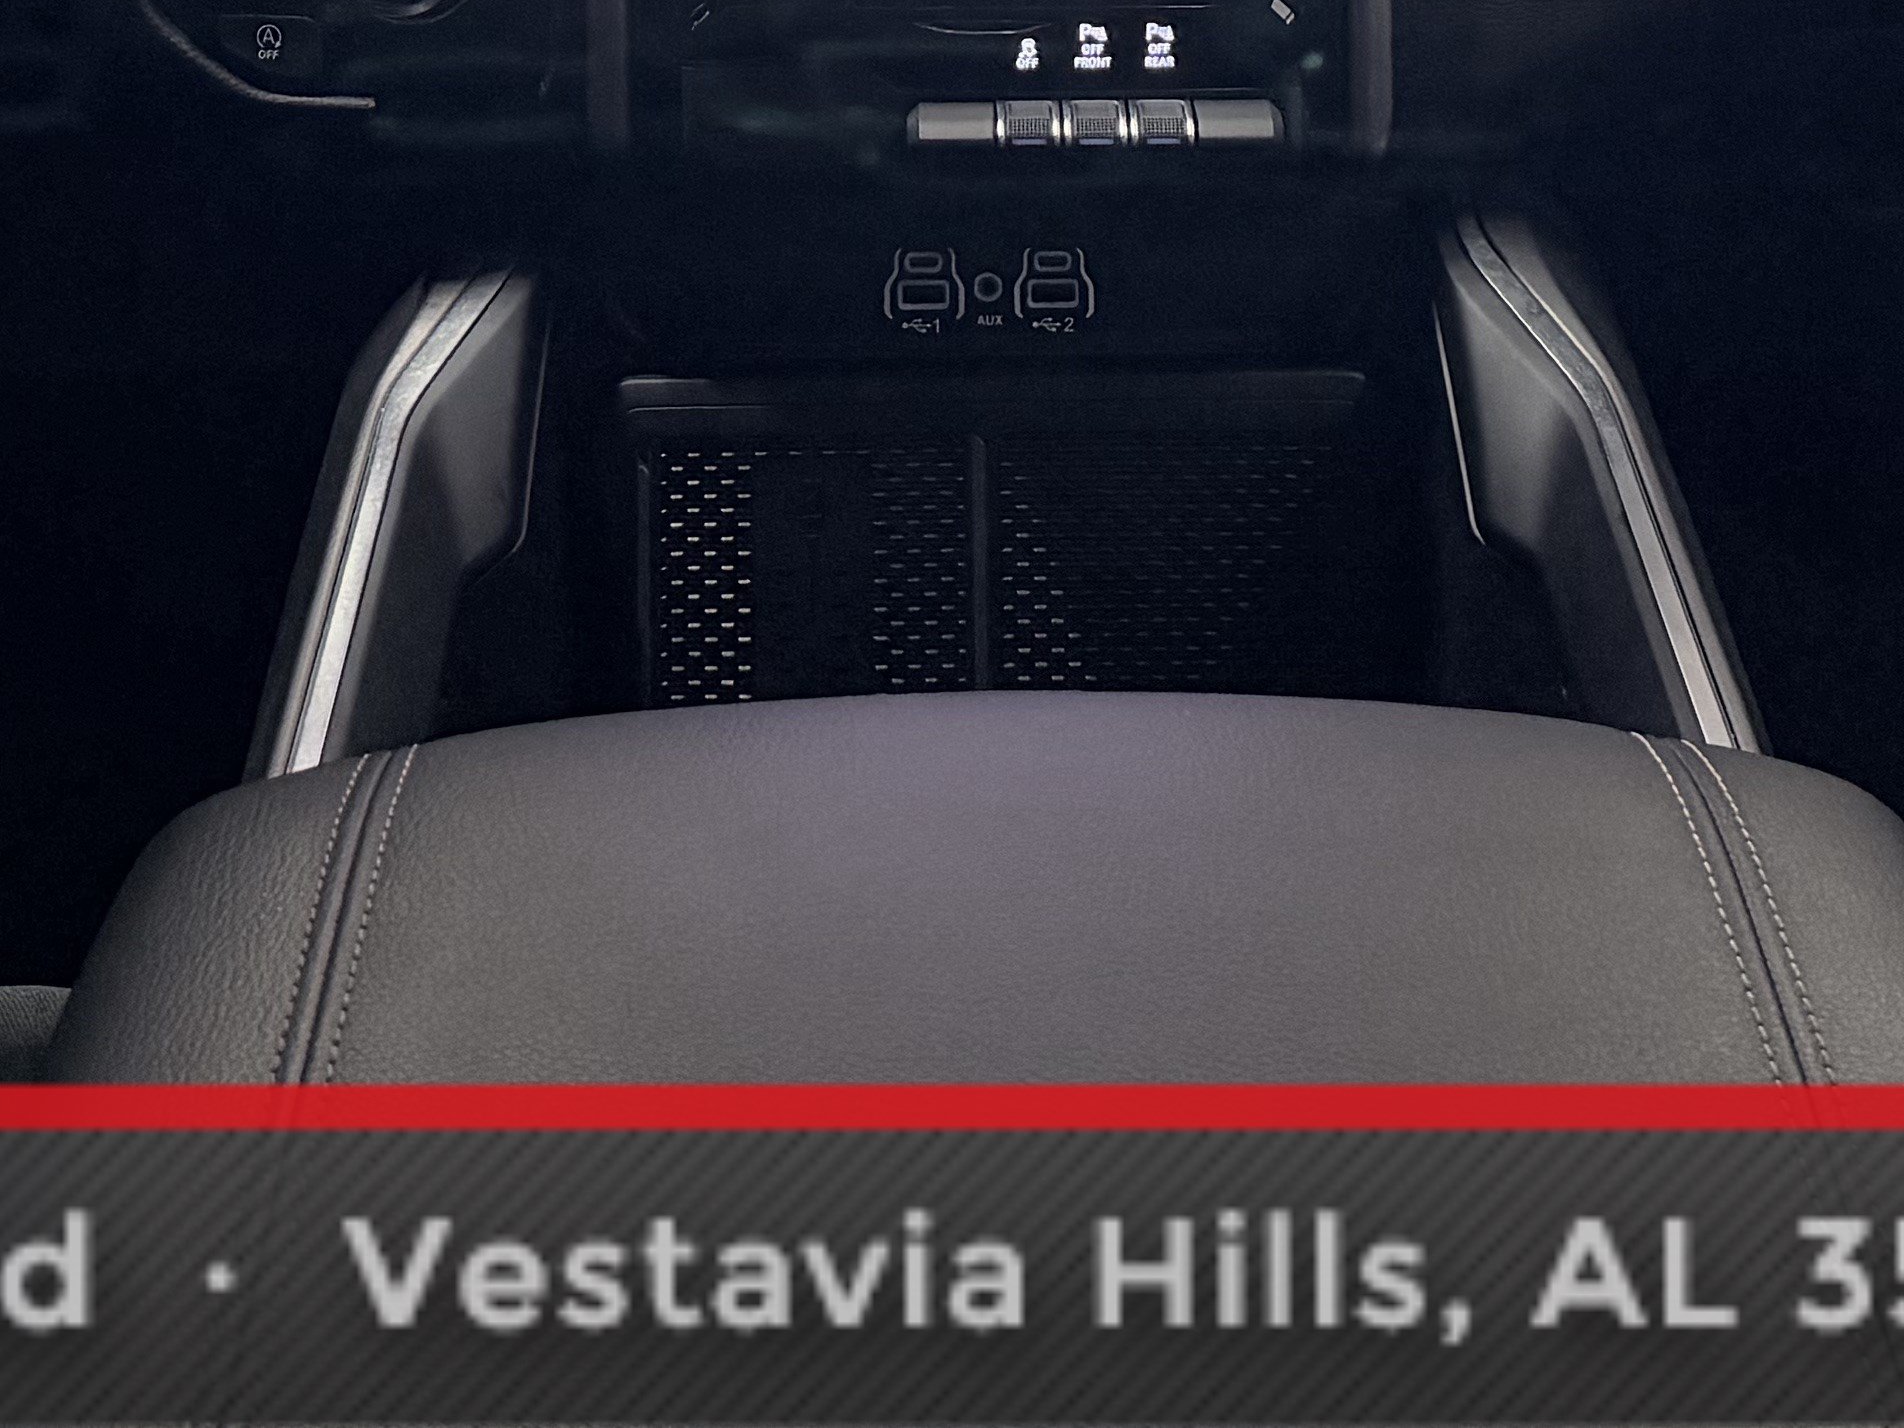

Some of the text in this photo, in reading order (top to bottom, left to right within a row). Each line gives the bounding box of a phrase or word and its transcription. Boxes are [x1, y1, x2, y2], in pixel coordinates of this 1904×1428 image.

[258, 50, 279, 60] OFF
[1081, 43, 1105, 55] OFF
[1147, 43, 1171, 55] OFF
[1016, 57, 1039, 69] OFF
[1074, 56, 1112, 68] FRONT
[1144, 56, 1176, 68] REAR
[977, 314, 1003, 326] AUX
[1063, 317, 1075, 333] 2
